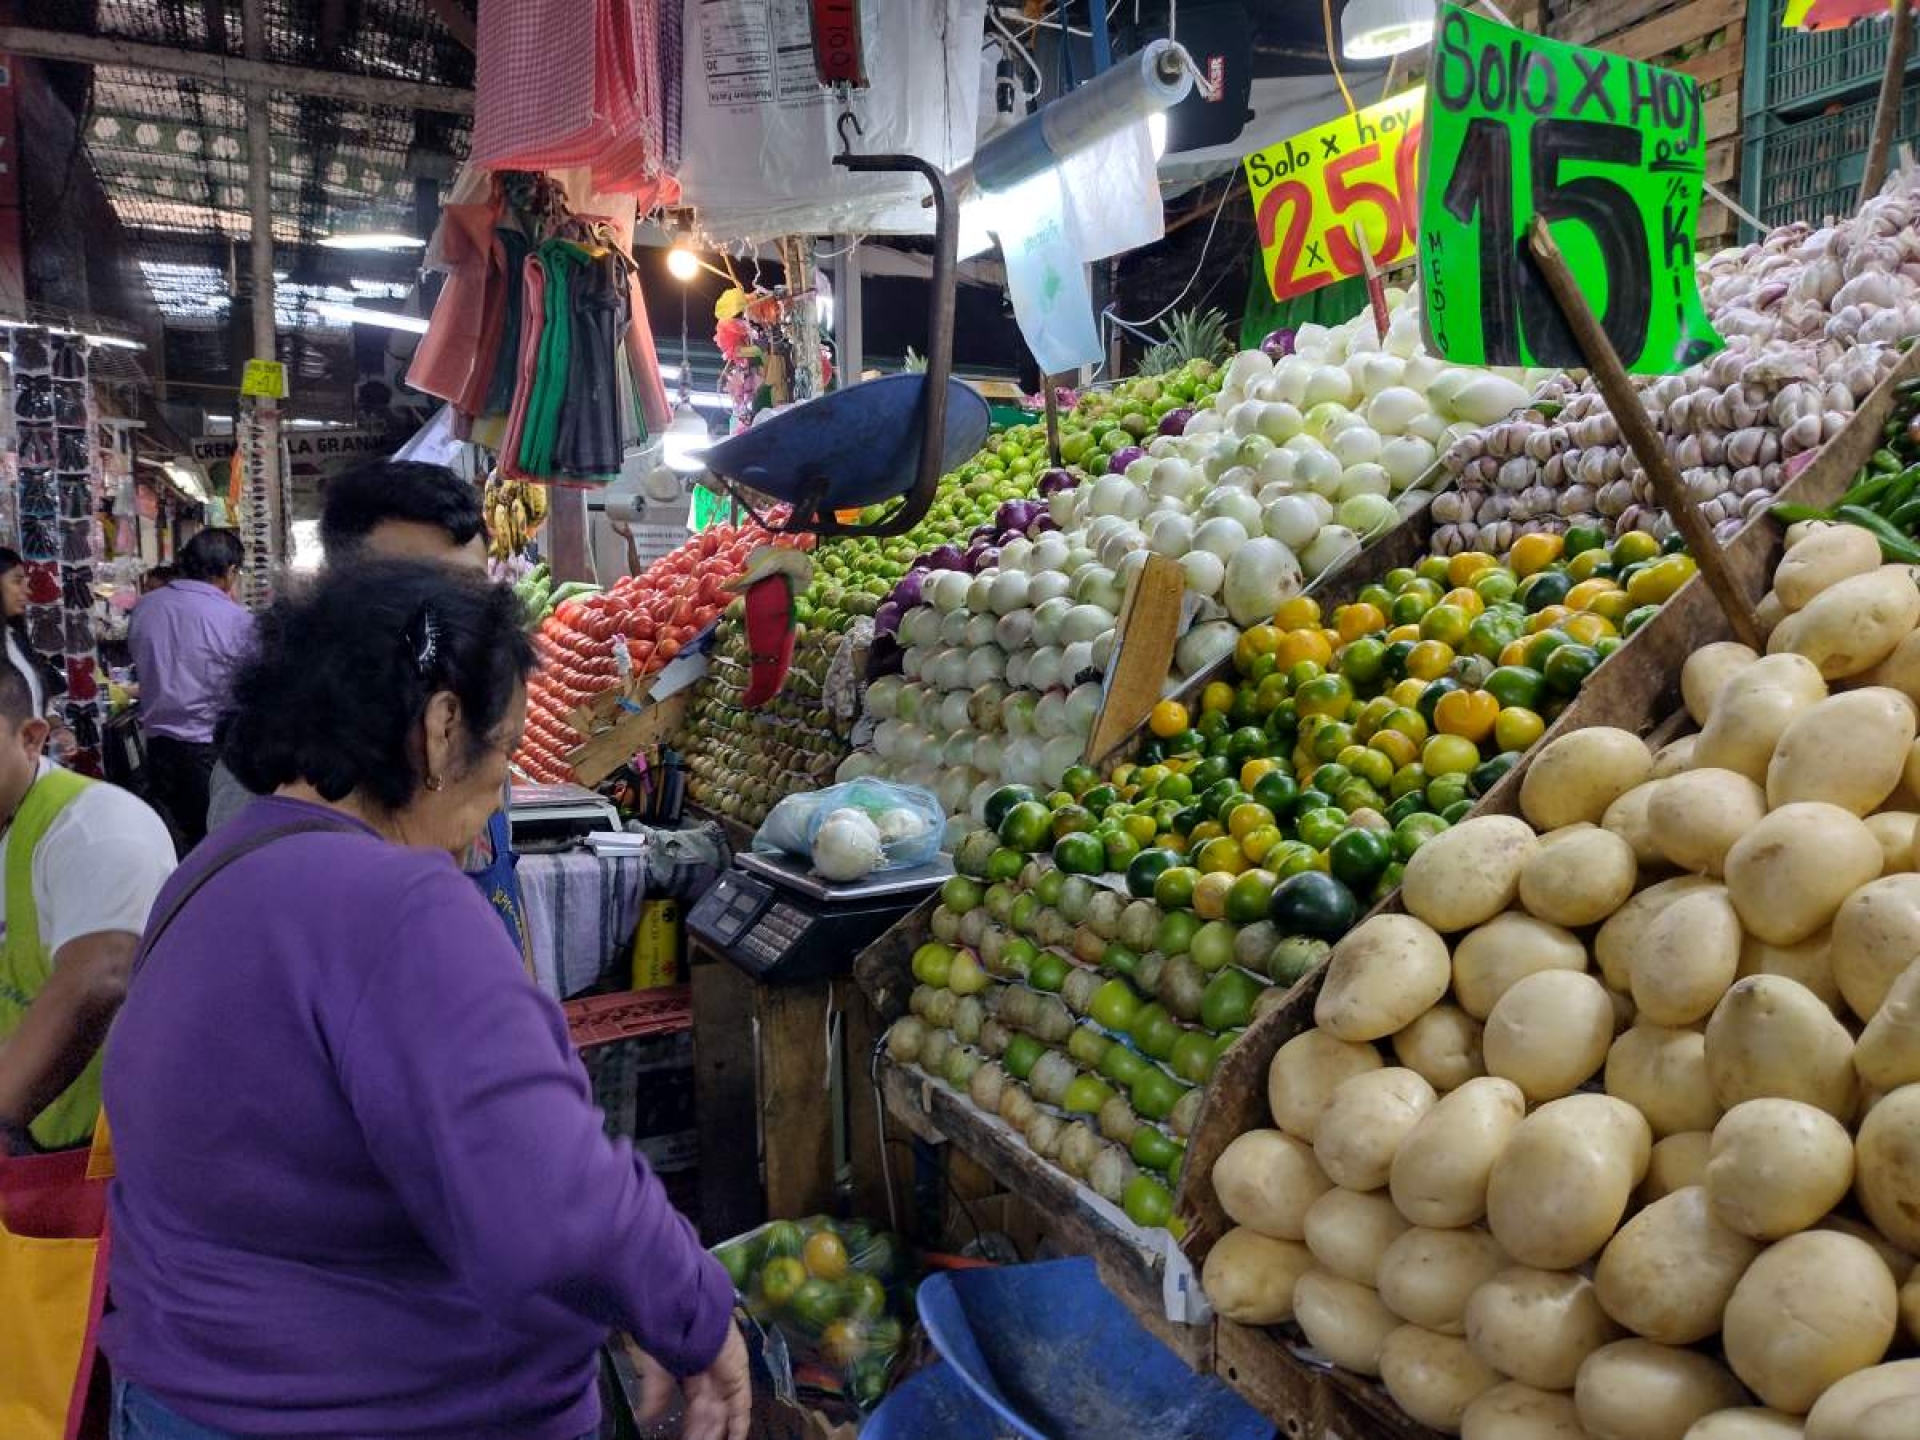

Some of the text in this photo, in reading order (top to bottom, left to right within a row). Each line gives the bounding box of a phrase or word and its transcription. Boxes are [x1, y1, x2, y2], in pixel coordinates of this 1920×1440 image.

[1436, 11, 1559, 114] Solo
[1250, 141, 1310, 188] Solo
[1356, 108, 1411, 144] hoy
[1442, 117, 1652, 368] 15
